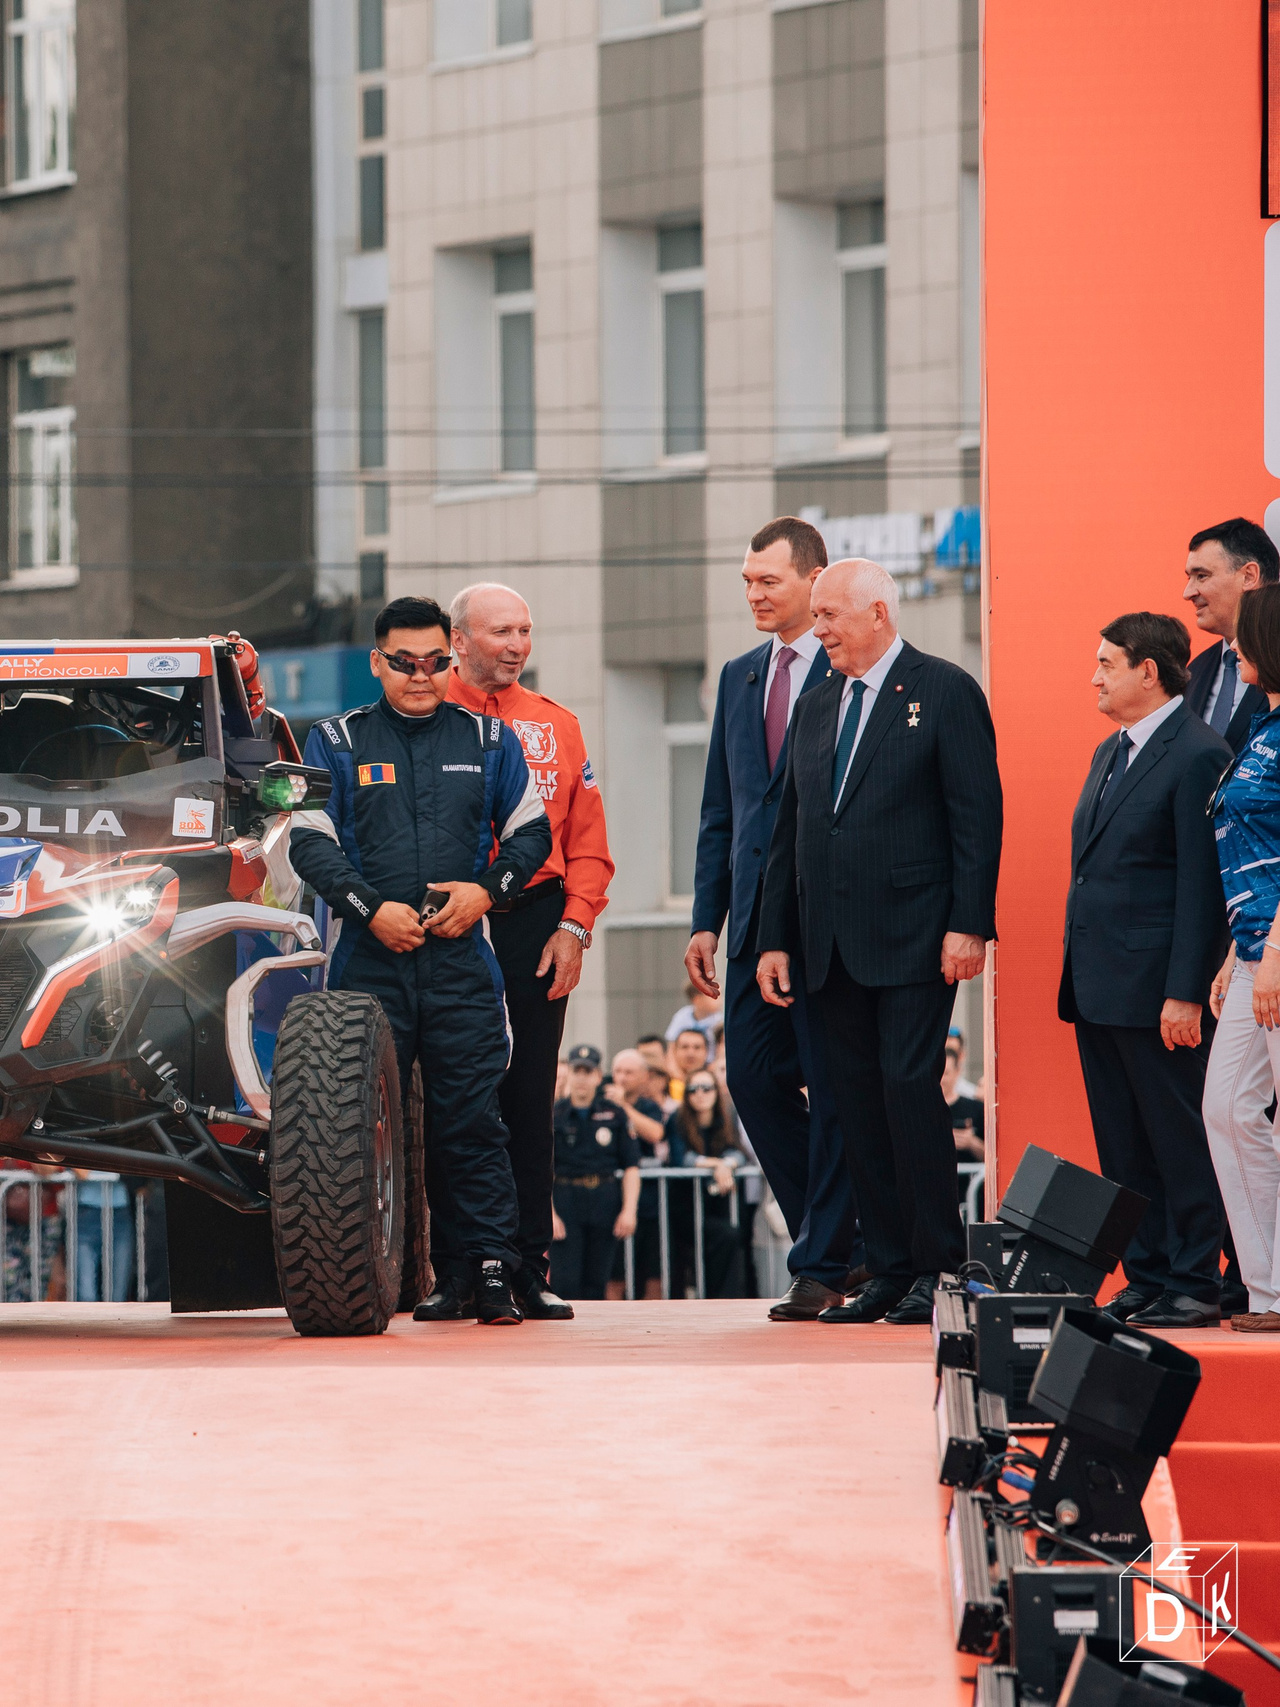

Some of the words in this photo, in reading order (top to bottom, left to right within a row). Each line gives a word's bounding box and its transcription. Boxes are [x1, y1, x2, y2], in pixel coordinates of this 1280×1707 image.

[24, 666, 121, 678] MONGOLIA
[321, 721, 341, 745] sparco
[179, 821, 195, 829] 80
[346, 891, 370, 917] sparco
